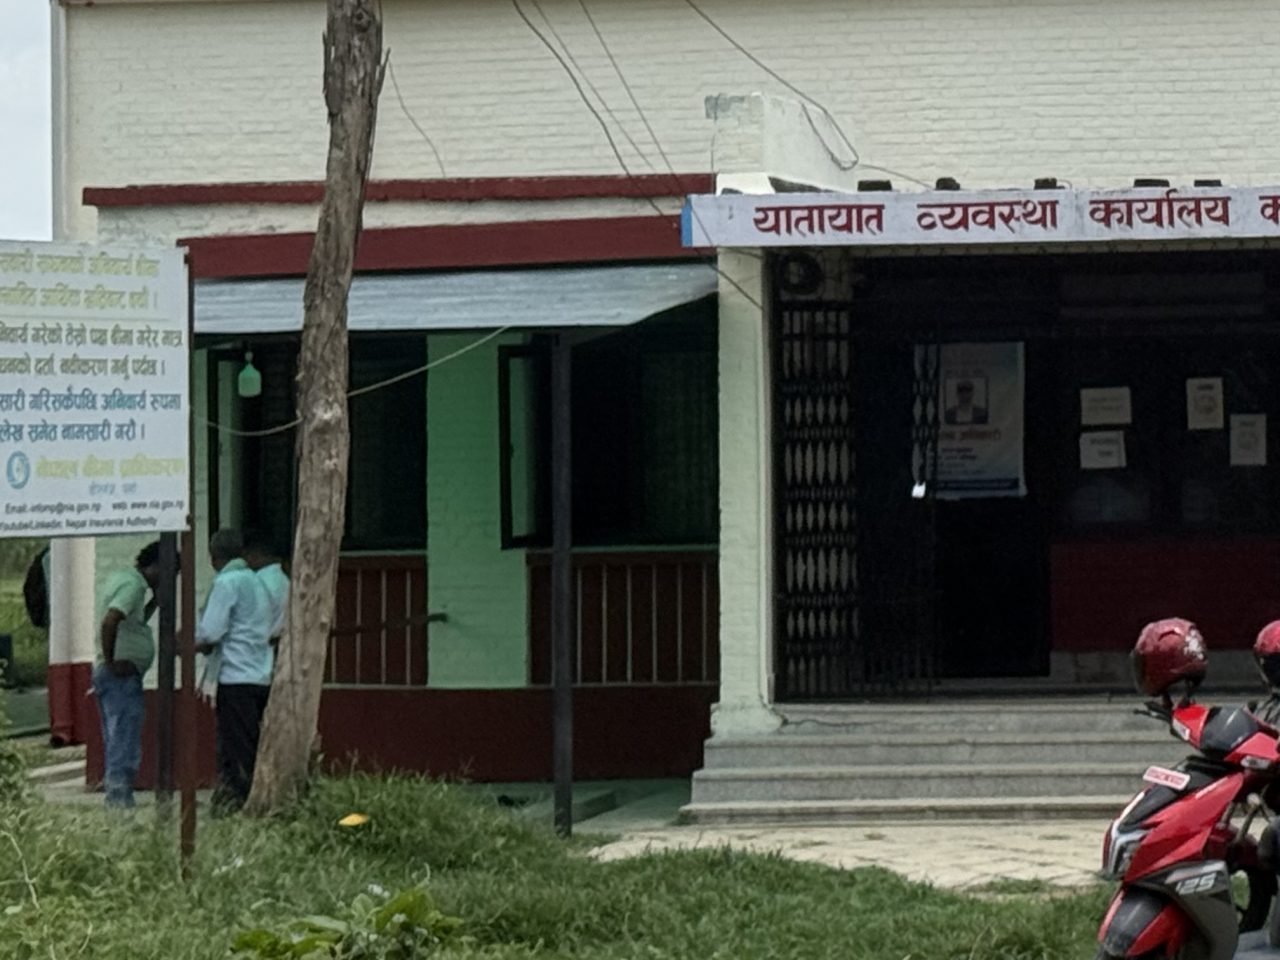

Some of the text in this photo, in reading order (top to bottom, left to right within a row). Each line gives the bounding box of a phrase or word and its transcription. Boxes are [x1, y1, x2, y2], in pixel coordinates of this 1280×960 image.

[753, 203, 886, 237] यातायात
[916, 199, 1059, 234] व्यवस्था
[1088, 188, 1232, 228] कार्यालय
